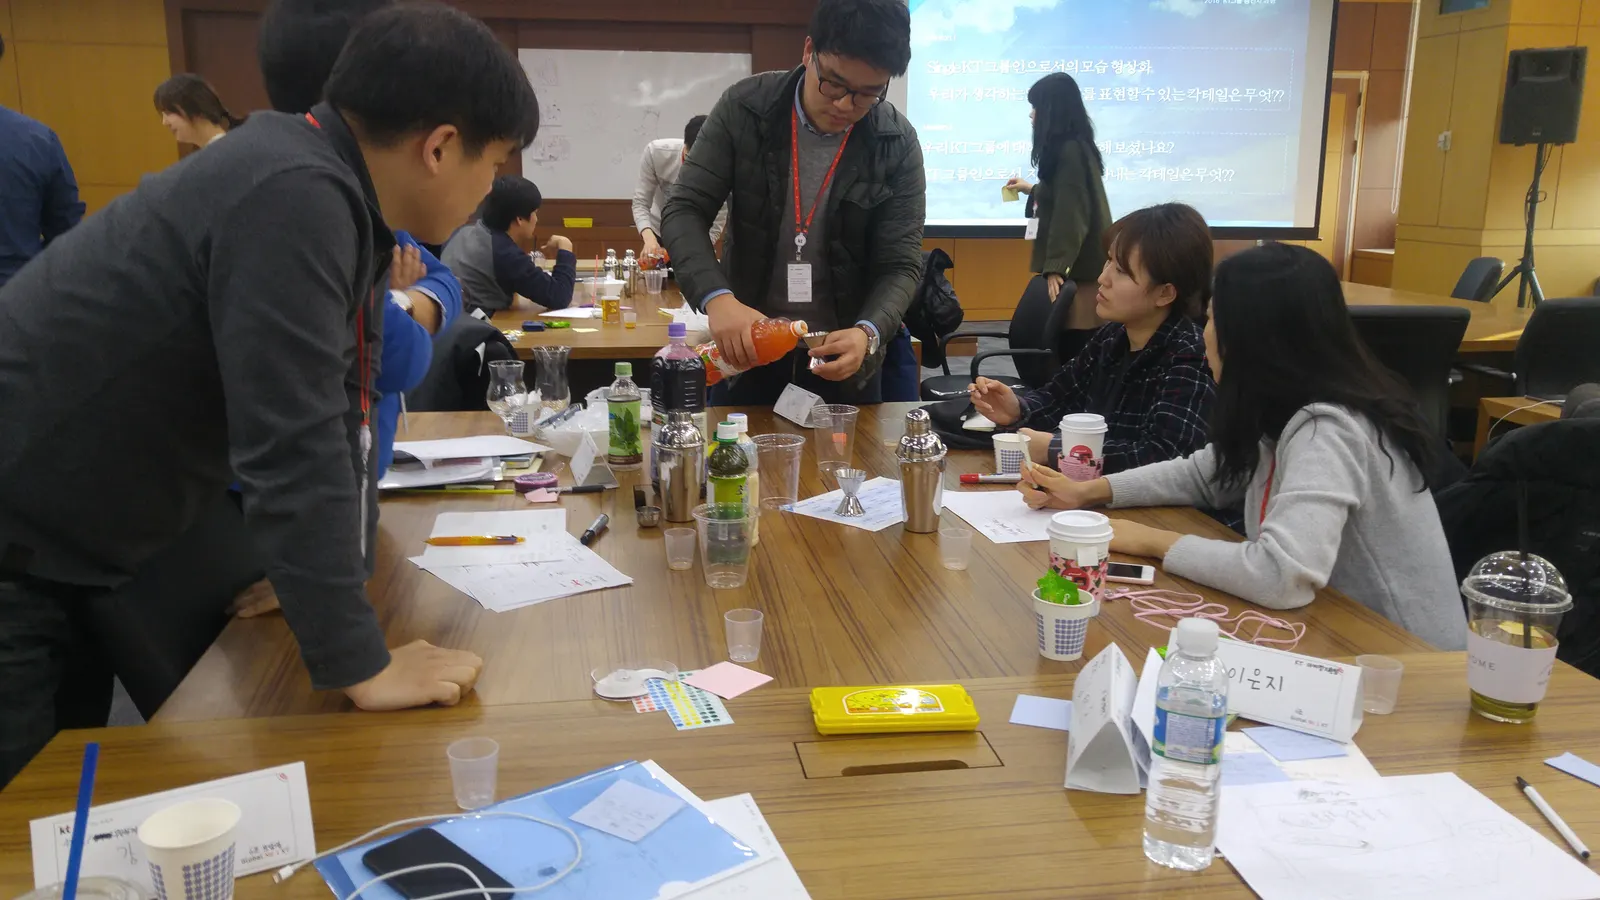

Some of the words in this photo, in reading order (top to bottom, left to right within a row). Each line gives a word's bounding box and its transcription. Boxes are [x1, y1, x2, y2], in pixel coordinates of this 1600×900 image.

[1080, 60, 1108, 74] 모습
[1111, 60, 1152, 75] 형상화
[927, 87, 968, 102] 우리가
[972, 87, 1026, 102] 생각하는
[1112, 141, 1175, 156] 보셨나요?
[1228, 667, 1284, 692] 이은지
